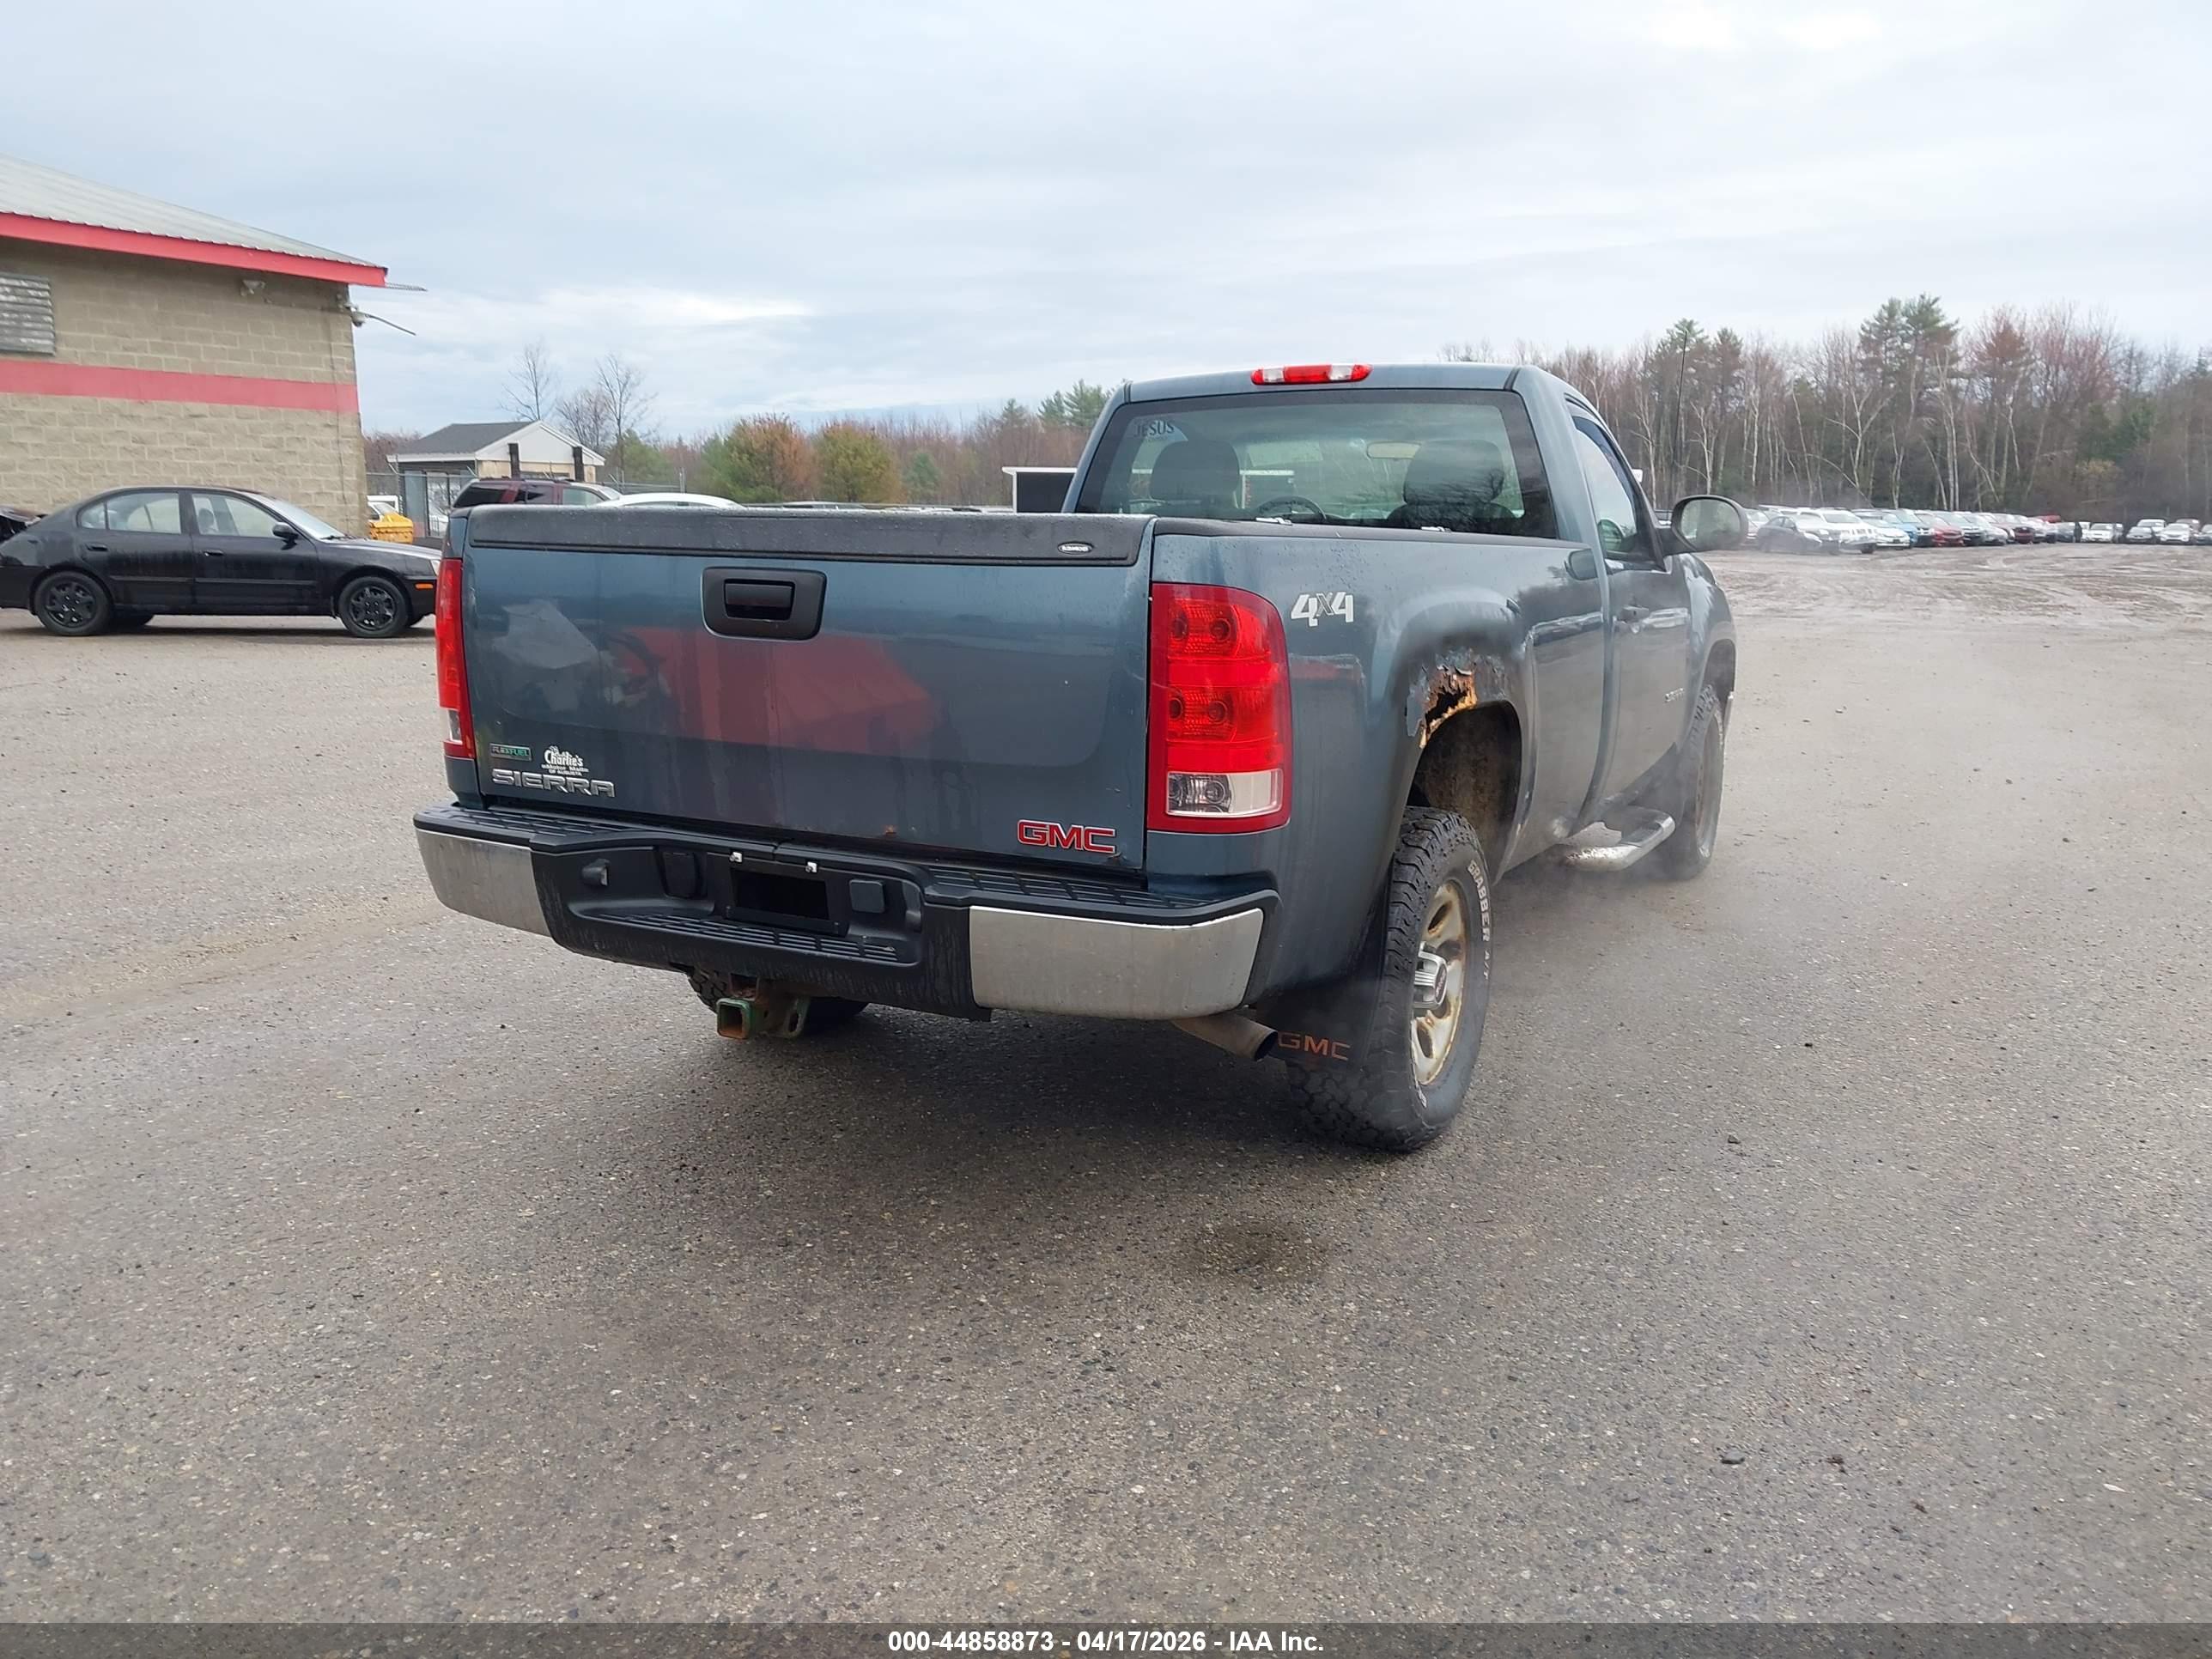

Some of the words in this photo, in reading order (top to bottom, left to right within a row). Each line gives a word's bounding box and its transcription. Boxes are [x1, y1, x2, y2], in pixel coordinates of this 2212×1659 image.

[544, 746, 584, 767] Charlie's
[492, 769, 616, 798] SIERRA
[1018, 819, 1115, 854] GMC
[1467, 860, 1491, 942] GRABBER
[1278, 1031, 1351, 1062] GMC
